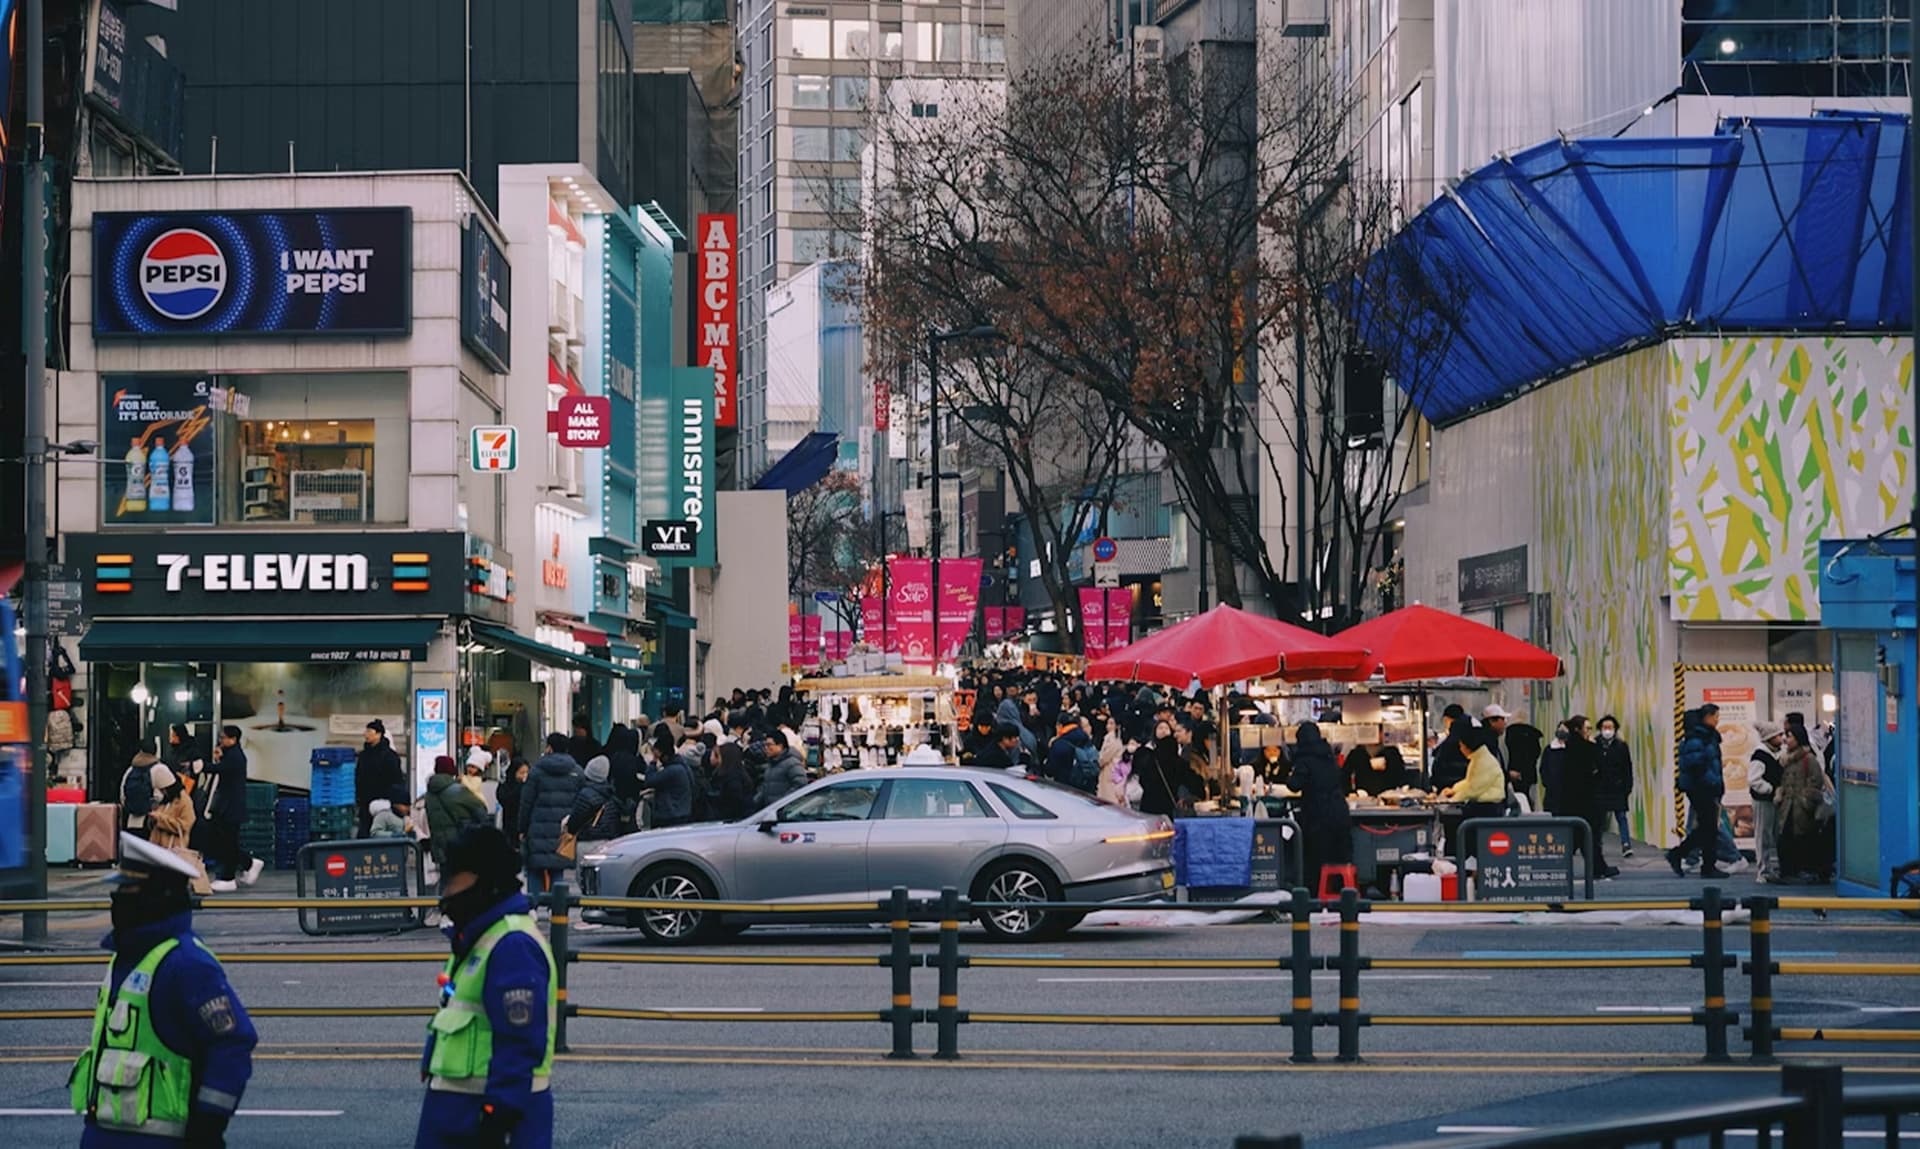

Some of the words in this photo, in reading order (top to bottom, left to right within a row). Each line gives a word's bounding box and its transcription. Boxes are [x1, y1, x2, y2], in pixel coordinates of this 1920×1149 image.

[281, 250, 289, 270] I
[293, 249, 374, 270] WANT
[145, 264, 221, 284] PEPSI
[286, 272, 366, 294] PEPSI
[119, 400, 140, 411] FOR
[141, 400, 160, 412] ME,
[573, 403, 594, 414] ALL
[119, 411, 138, 421] IT'S
[139, 410, 195, 421] GATORADE
[568, 416, 600, 427] MASK
[567, 429, 600, 440] STORY
[656, 526, 687, 543] VT
[651, 542, 691, 551] COSMETICS
